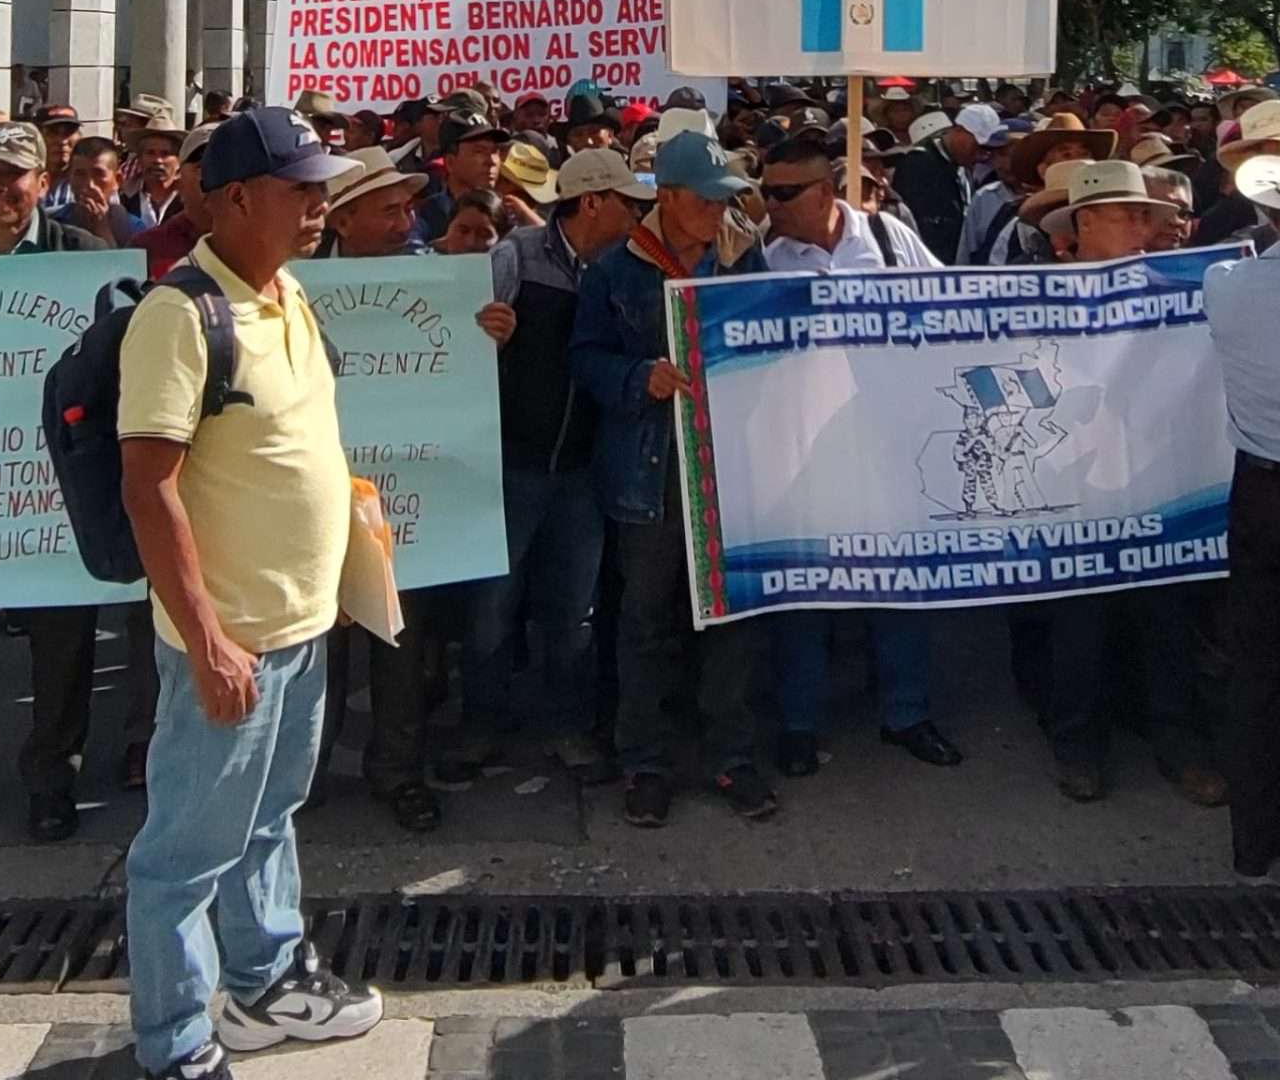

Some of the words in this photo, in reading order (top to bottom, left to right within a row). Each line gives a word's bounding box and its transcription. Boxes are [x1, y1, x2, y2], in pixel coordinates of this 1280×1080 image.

[289, 2, 452, 37] PRESIDENTE
[289, 42, 319, 70] LA
[326, 35, 530, 69] COMPENSACION
[546, 31, 579, 60] AL
[288, 73, 421, 102] PRESTADO
[592, 61, 641, 86] POR
[811, 273, 1040, 306] EXPATRULLEROS
[1047, 266, 1149, 298] CIVILES
[723, 318, 783, 347] SAN
[790, 313, 883, 342] PEDRO
[924, 307, 983, 338] SAN
[990, 302, 1089, 332] PEDRO
[35, 426, 48, 452] D
[828, 528, 1003, 558] HOMBRES
[1007, 525, 1036, 552] Y
[1036, 513, 1164, 548] VIUDAS
[761, 558, 1048, 596] DEPARTAMENTO
[1052, 550, 1115, 583] DEL
